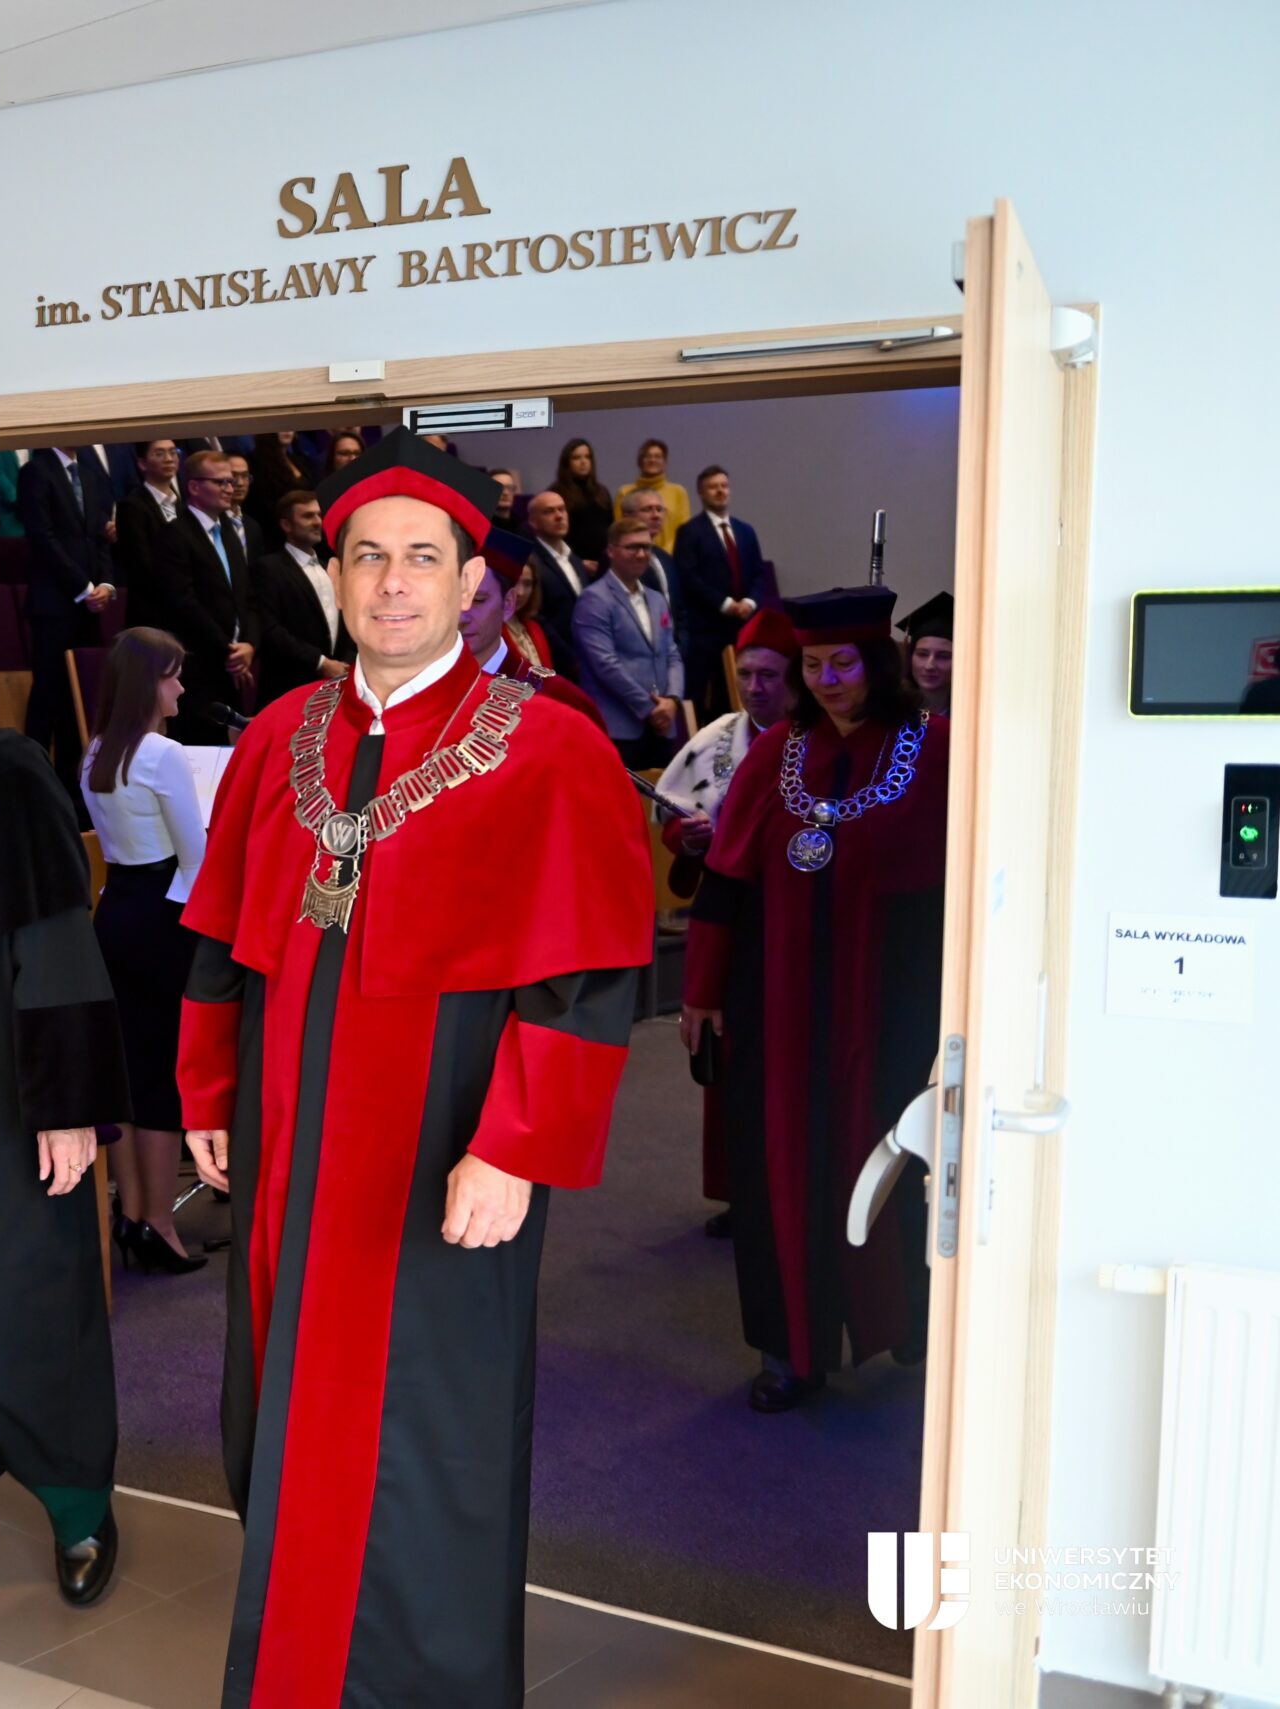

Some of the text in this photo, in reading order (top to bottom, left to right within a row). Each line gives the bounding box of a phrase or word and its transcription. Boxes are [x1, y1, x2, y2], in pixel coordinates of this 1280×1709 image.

[277, 157, 491, 239] SALA
[35, 208, 799, 327] im. STANISŁAWY BARTOSIEWICZ
[1115, 928, 1247, 945] SALA WYKŁADOWA
[1174, 956, 1184, 975] 1
